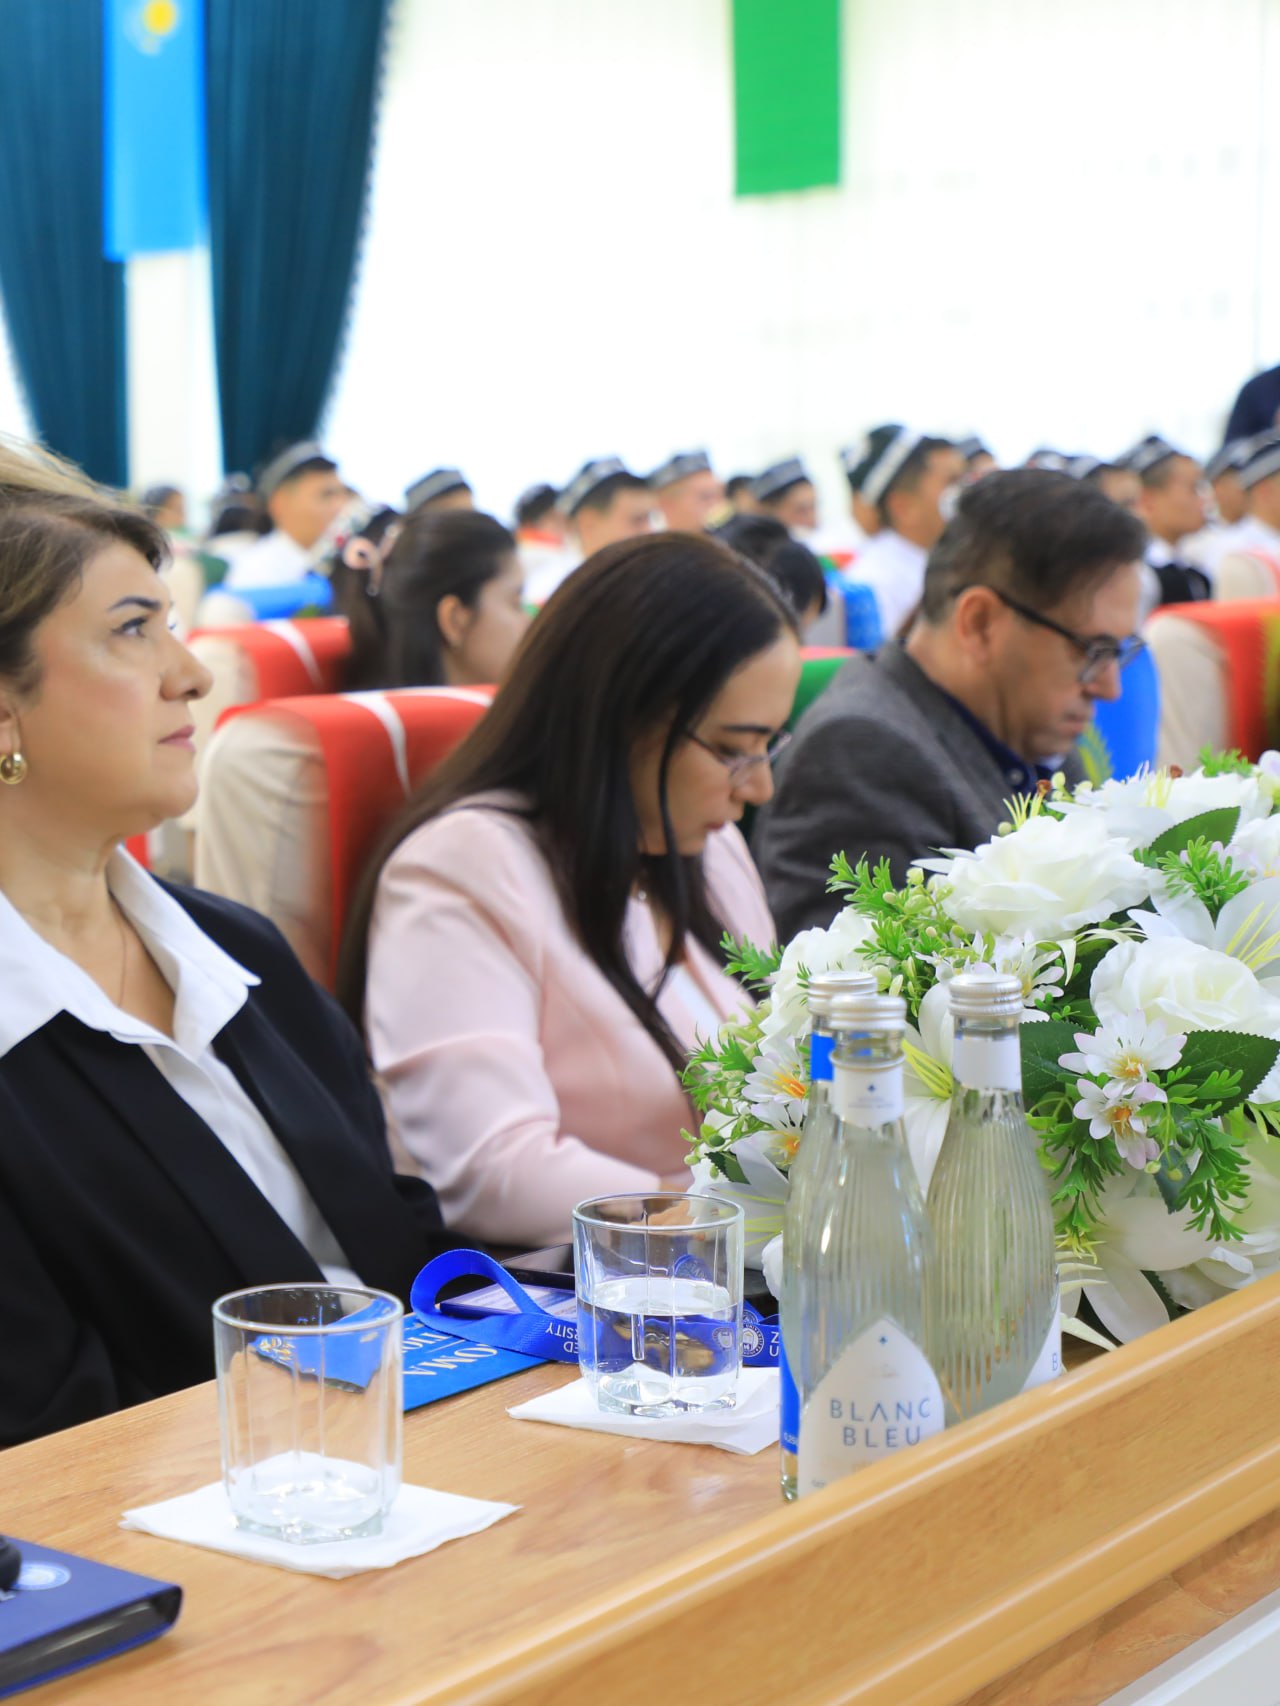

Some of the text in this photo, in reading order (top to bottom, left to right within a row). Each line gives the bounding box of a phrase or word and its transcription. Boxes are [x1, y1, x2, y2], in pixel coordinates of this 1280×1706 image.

[402, 1343, 498, 1375] OMA
[830, 1397, 931, 1422] BLANC
[843, 1425, 922, 1448] BLEU
